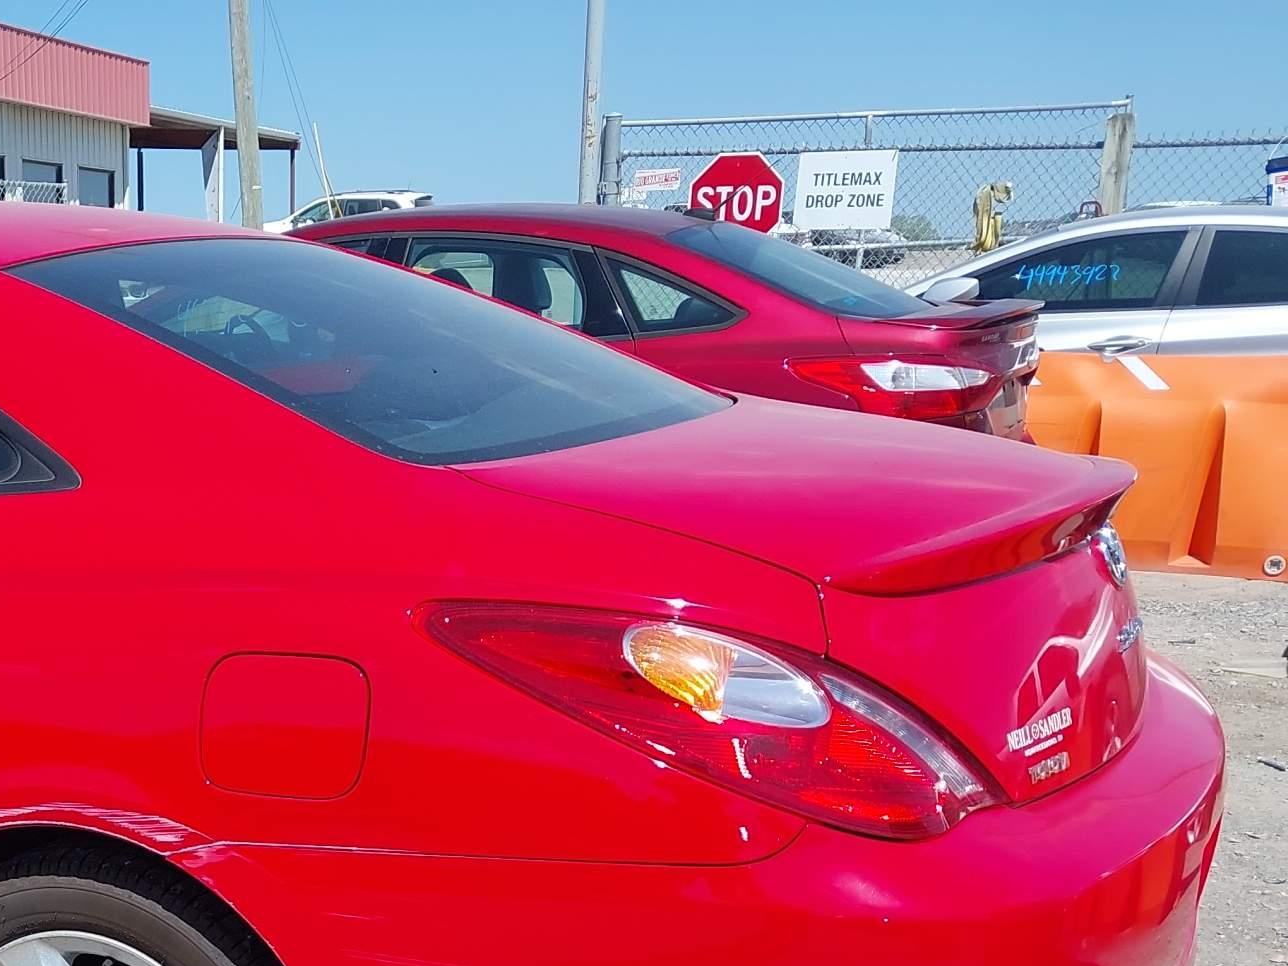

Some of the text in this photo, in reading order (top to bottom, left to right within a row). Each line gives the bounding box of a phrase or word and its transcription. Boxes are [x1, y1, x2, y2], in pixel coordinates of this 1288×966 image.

[813, 172, 883, 187] TITLEMAX
[697, 185, 777, 221] STOP
[805, 193, 885, 208] DROP ZONE
[1006, 725, 1034, 752] NEILL
[1038, 707, 1073, 739] SANDLER
